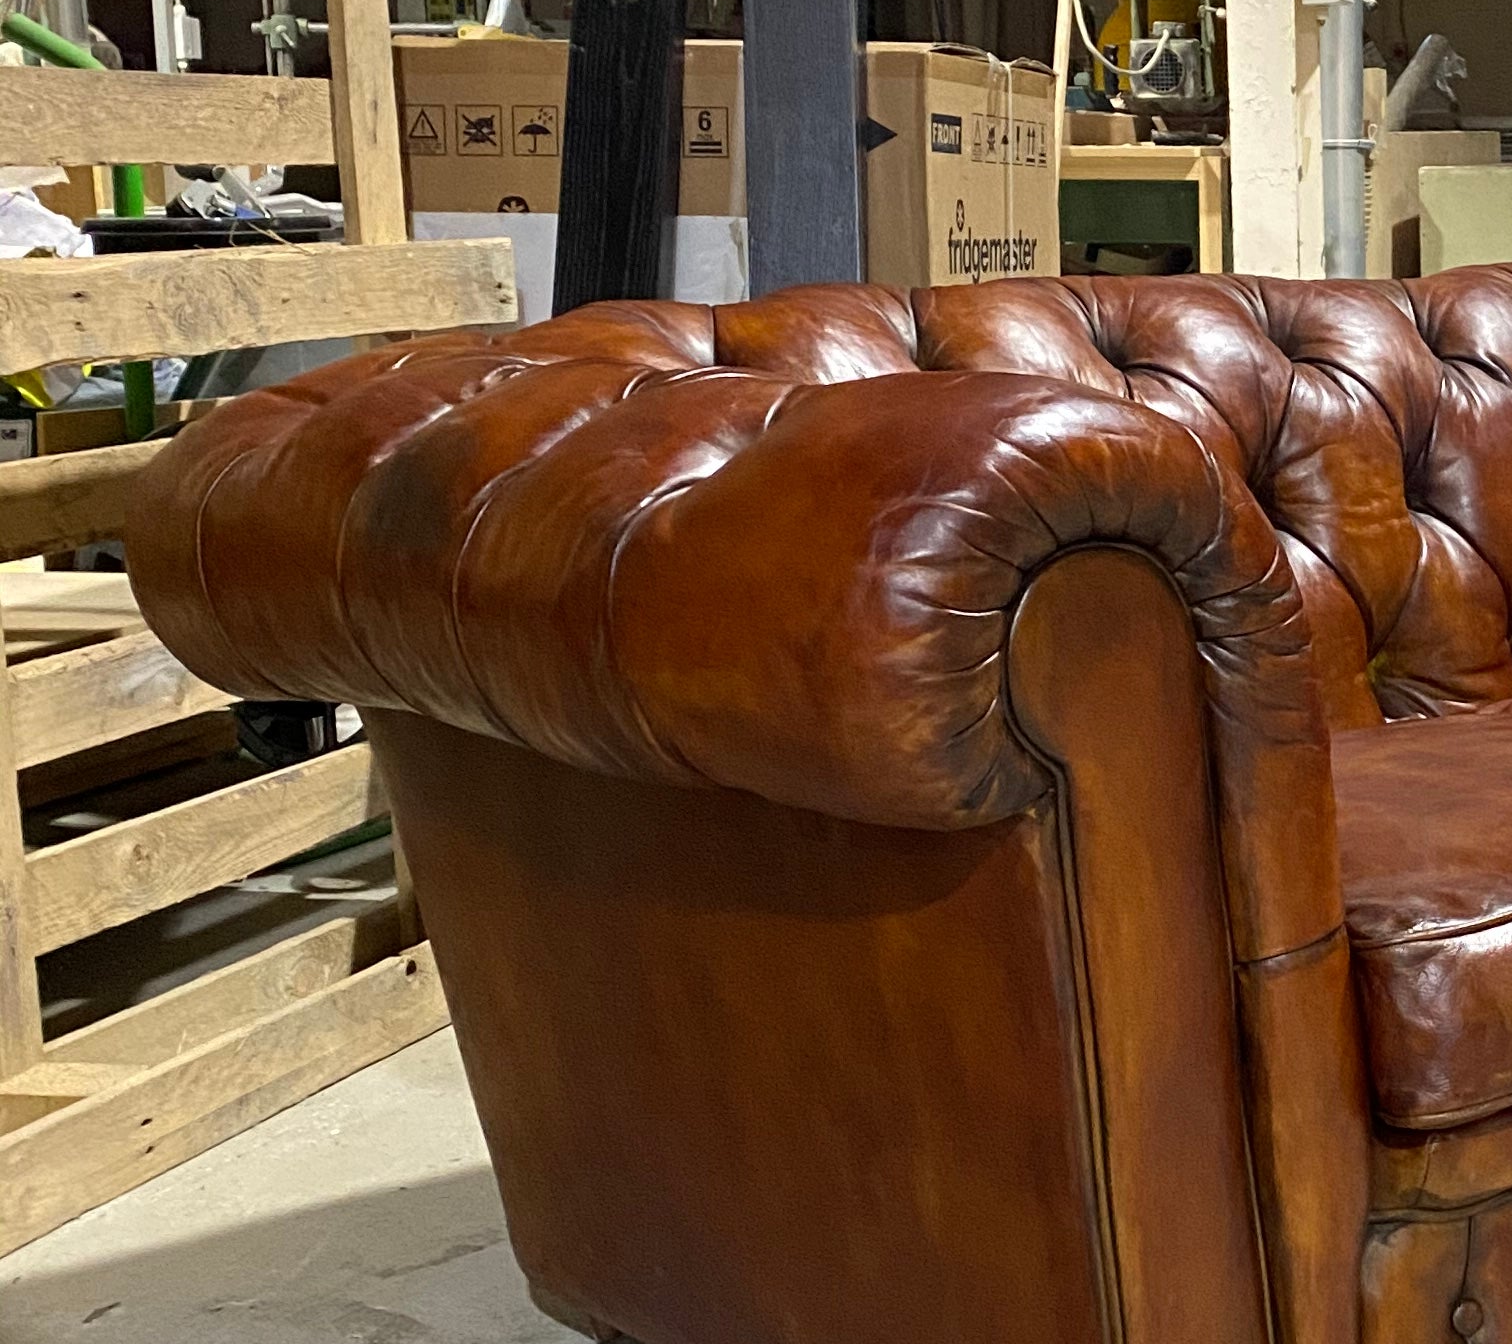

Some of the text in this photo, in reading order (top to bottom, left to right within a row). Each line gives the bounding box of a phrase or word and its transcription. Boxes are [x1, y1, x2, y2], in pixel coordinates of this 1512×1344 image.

[698, 110, 712, 131] 6
[932, 122, 961, 145] FRONT
[948, 228, 1038, 283] fridgemaster
